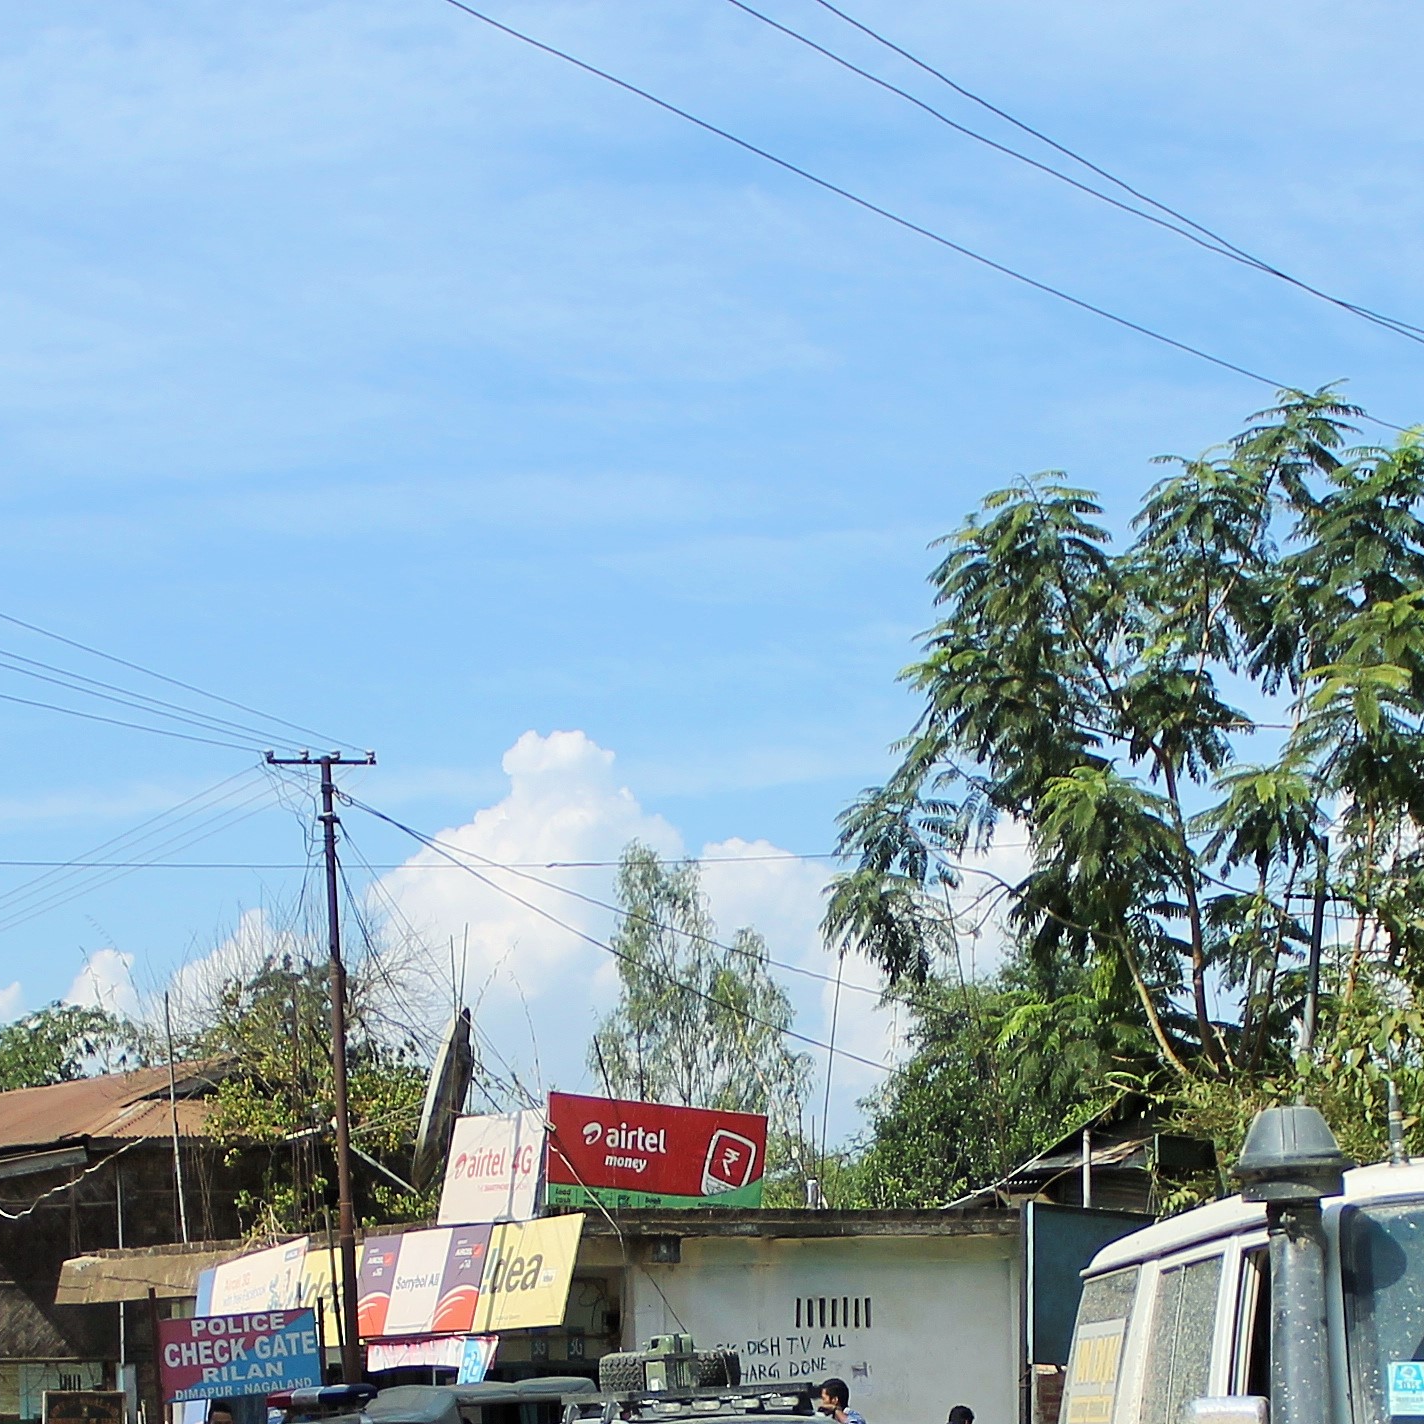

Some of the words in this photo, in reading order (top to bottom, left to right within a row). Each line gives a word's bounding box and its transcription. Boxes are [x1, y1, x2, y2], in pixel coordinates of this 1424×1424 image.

[605, 1122, 666, 1154] airtel
[467, 1147, 506, 1179] airtel
[511, 1144, 533, 1175] 4G
[604, 1154, 647, 1173] money
[190, 1312, 286, 1337] POLICE
[164, 1337, 248, 1368] CHECK
[254, 1330, 317, 1360] GATE
[747, 1337, 781, 1357] DISH
[823, 1334, 847, 1349] ALL
[202, 1361, 284, 1384] RILAN
[789, 1357, 827, 1377] DONE
[175, 1385, 233, 1401] DIMAPUR
[244, 1377, 313, 1395] NAGALAND
